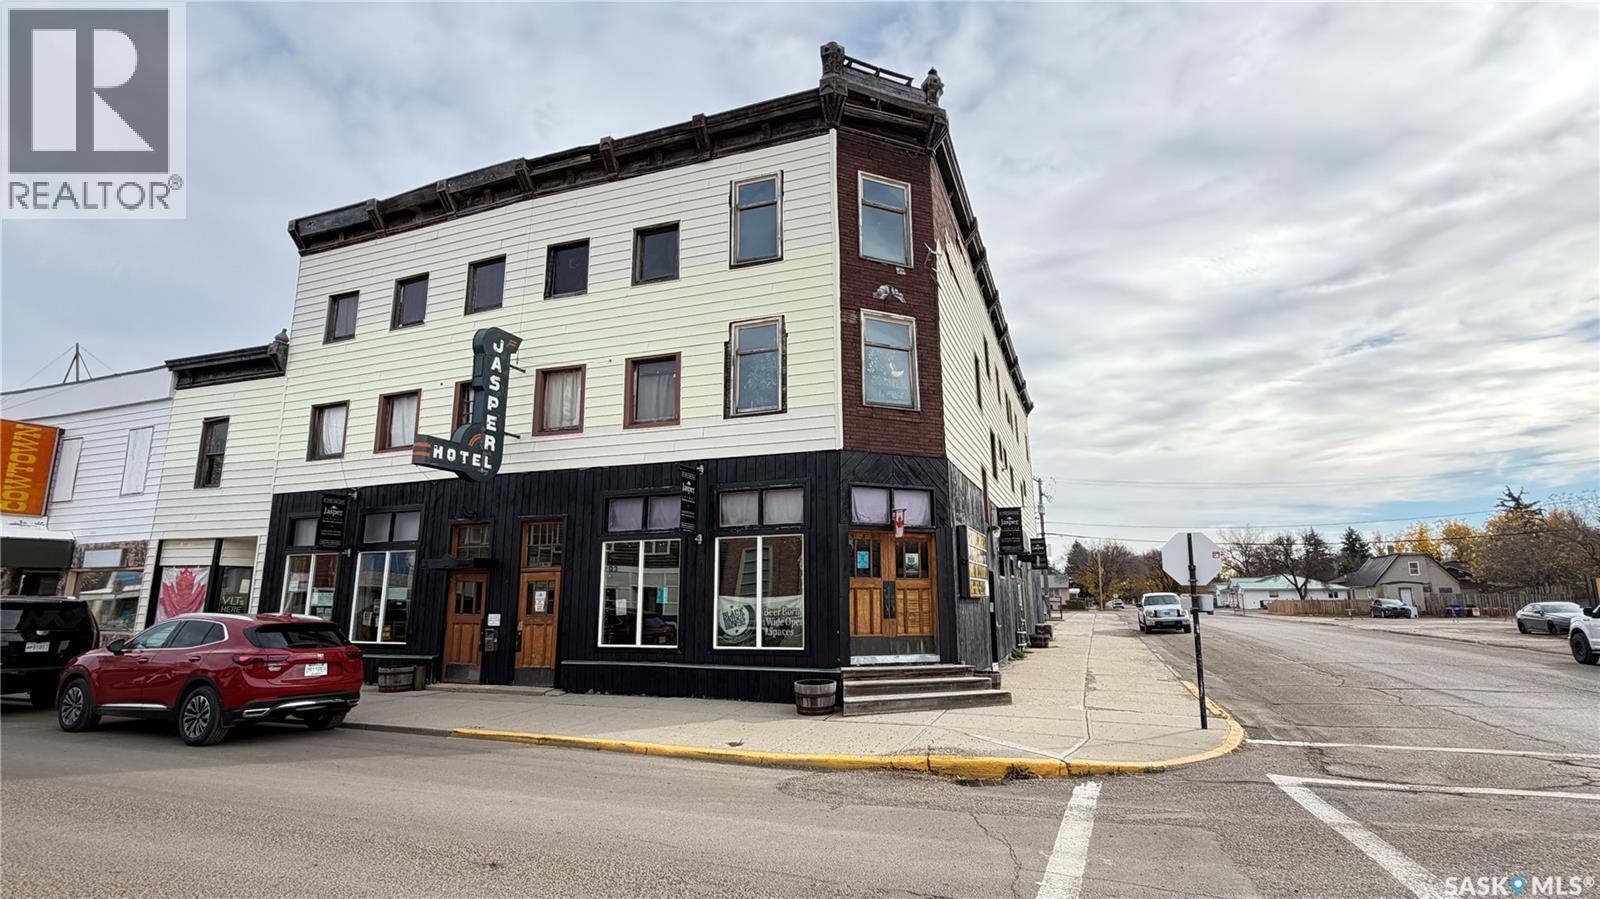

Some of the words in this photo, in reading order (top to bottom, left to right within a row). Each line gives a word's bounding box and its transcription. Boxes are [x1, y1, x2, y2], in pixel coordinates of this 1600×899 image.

[484, 339, 505, 452] JASPER
[432, 444, 492, 470] HOTEL
[0, 423, 42, 512] COWTOWN
[323, 507, 344, 517] Jasper
[221, 605, 242, 613] HERE
[768, 626, 794, 638] Spaces
